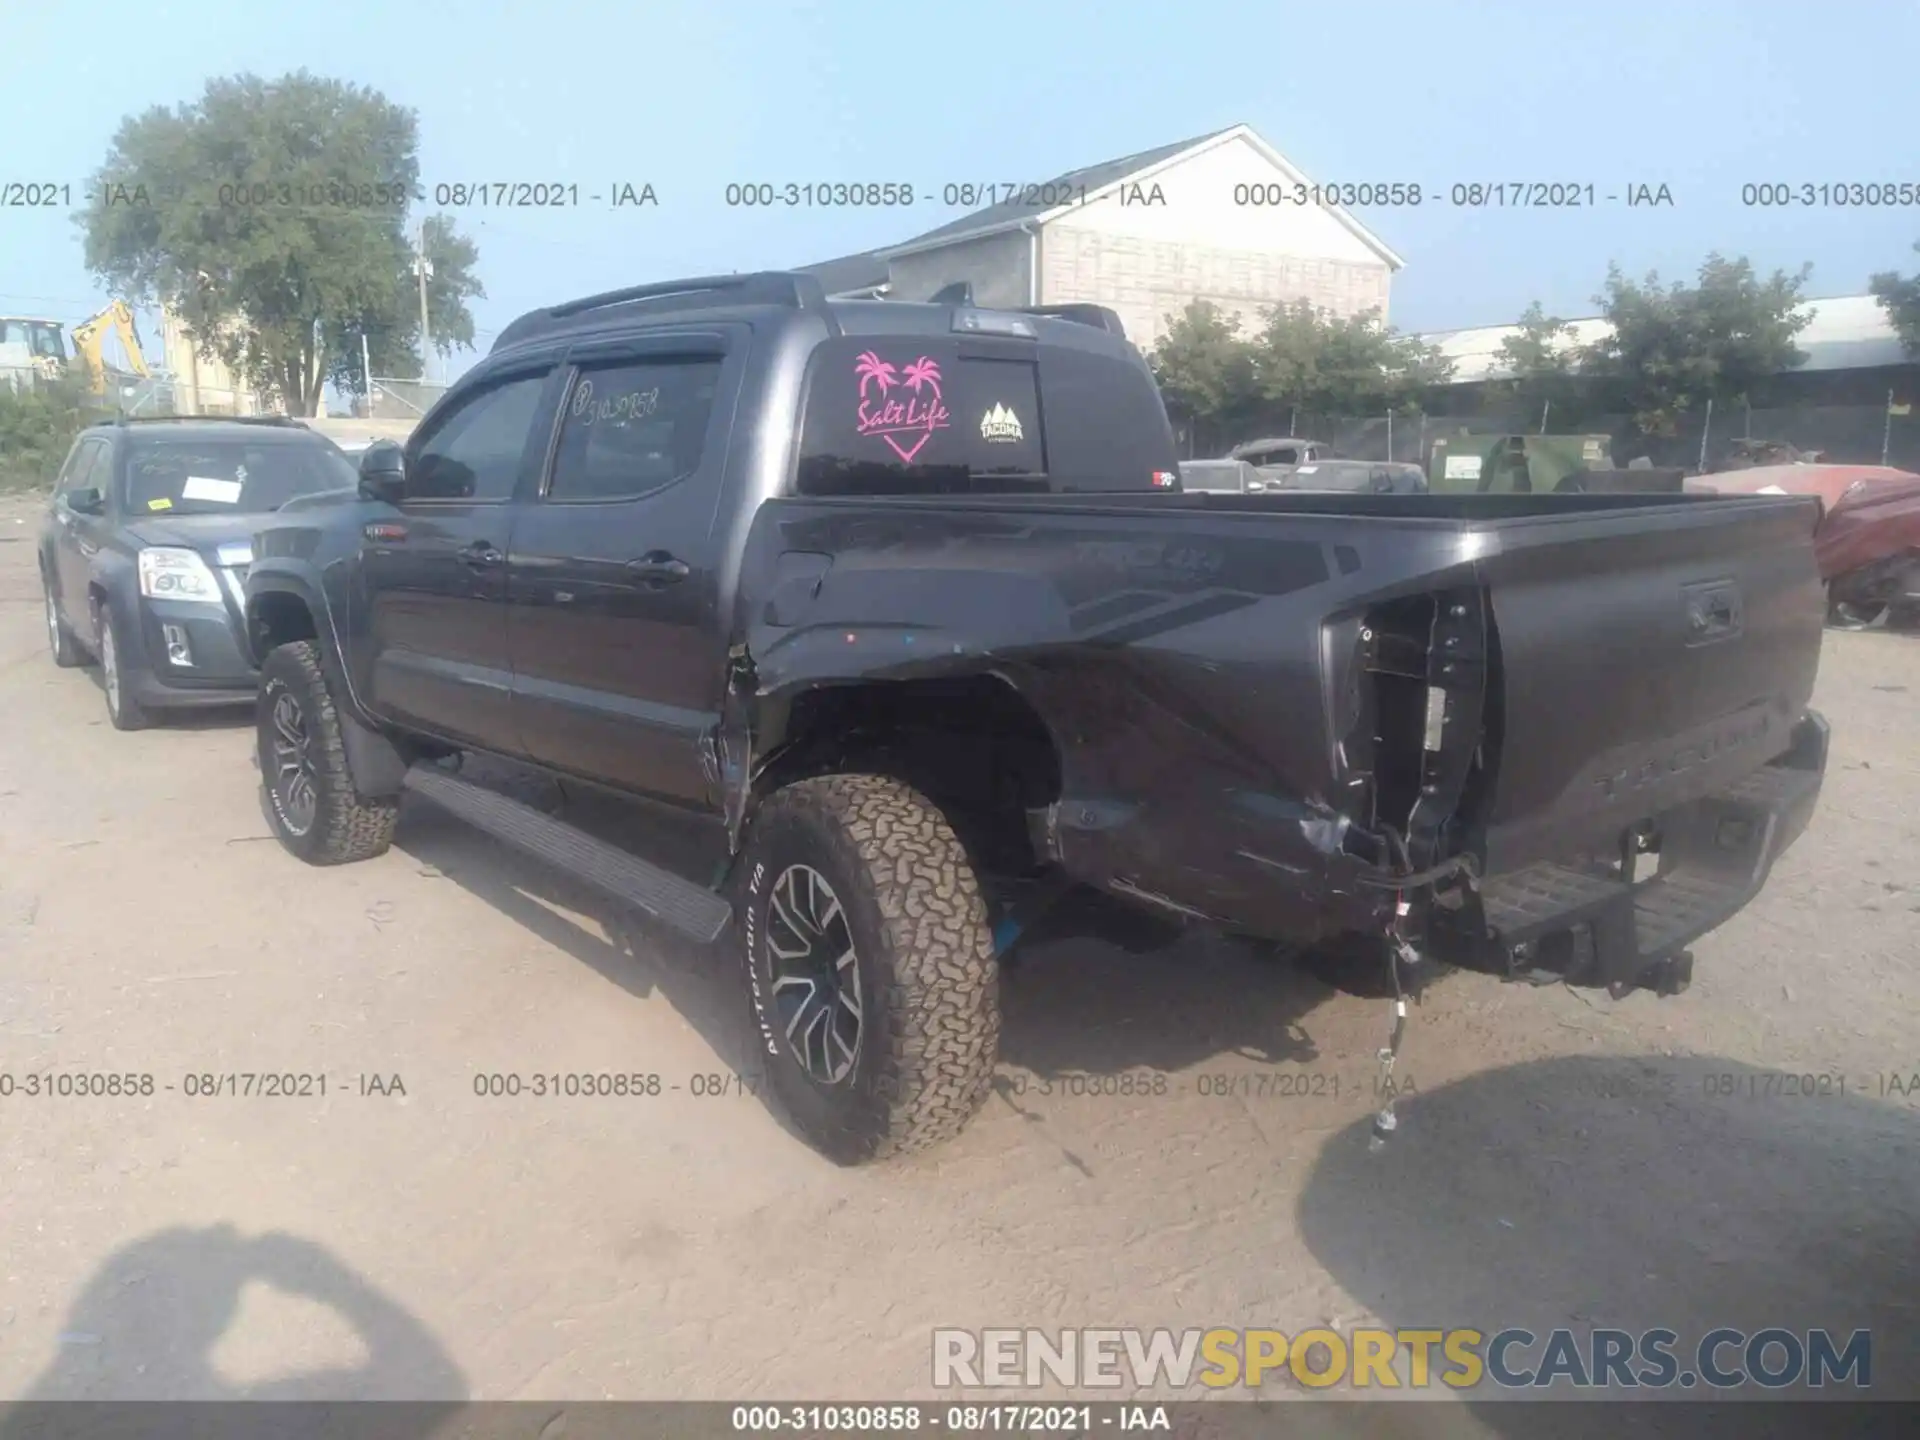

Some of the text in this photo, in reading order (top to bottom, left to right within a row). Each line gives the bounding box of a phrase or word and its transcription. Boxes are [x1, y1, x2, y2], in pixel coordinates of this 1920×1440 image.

[857, 397, 950, 431] Salt Life
[980, 423, 1024, 440] TACOMA
[749, 862, 765, 894] T/A
